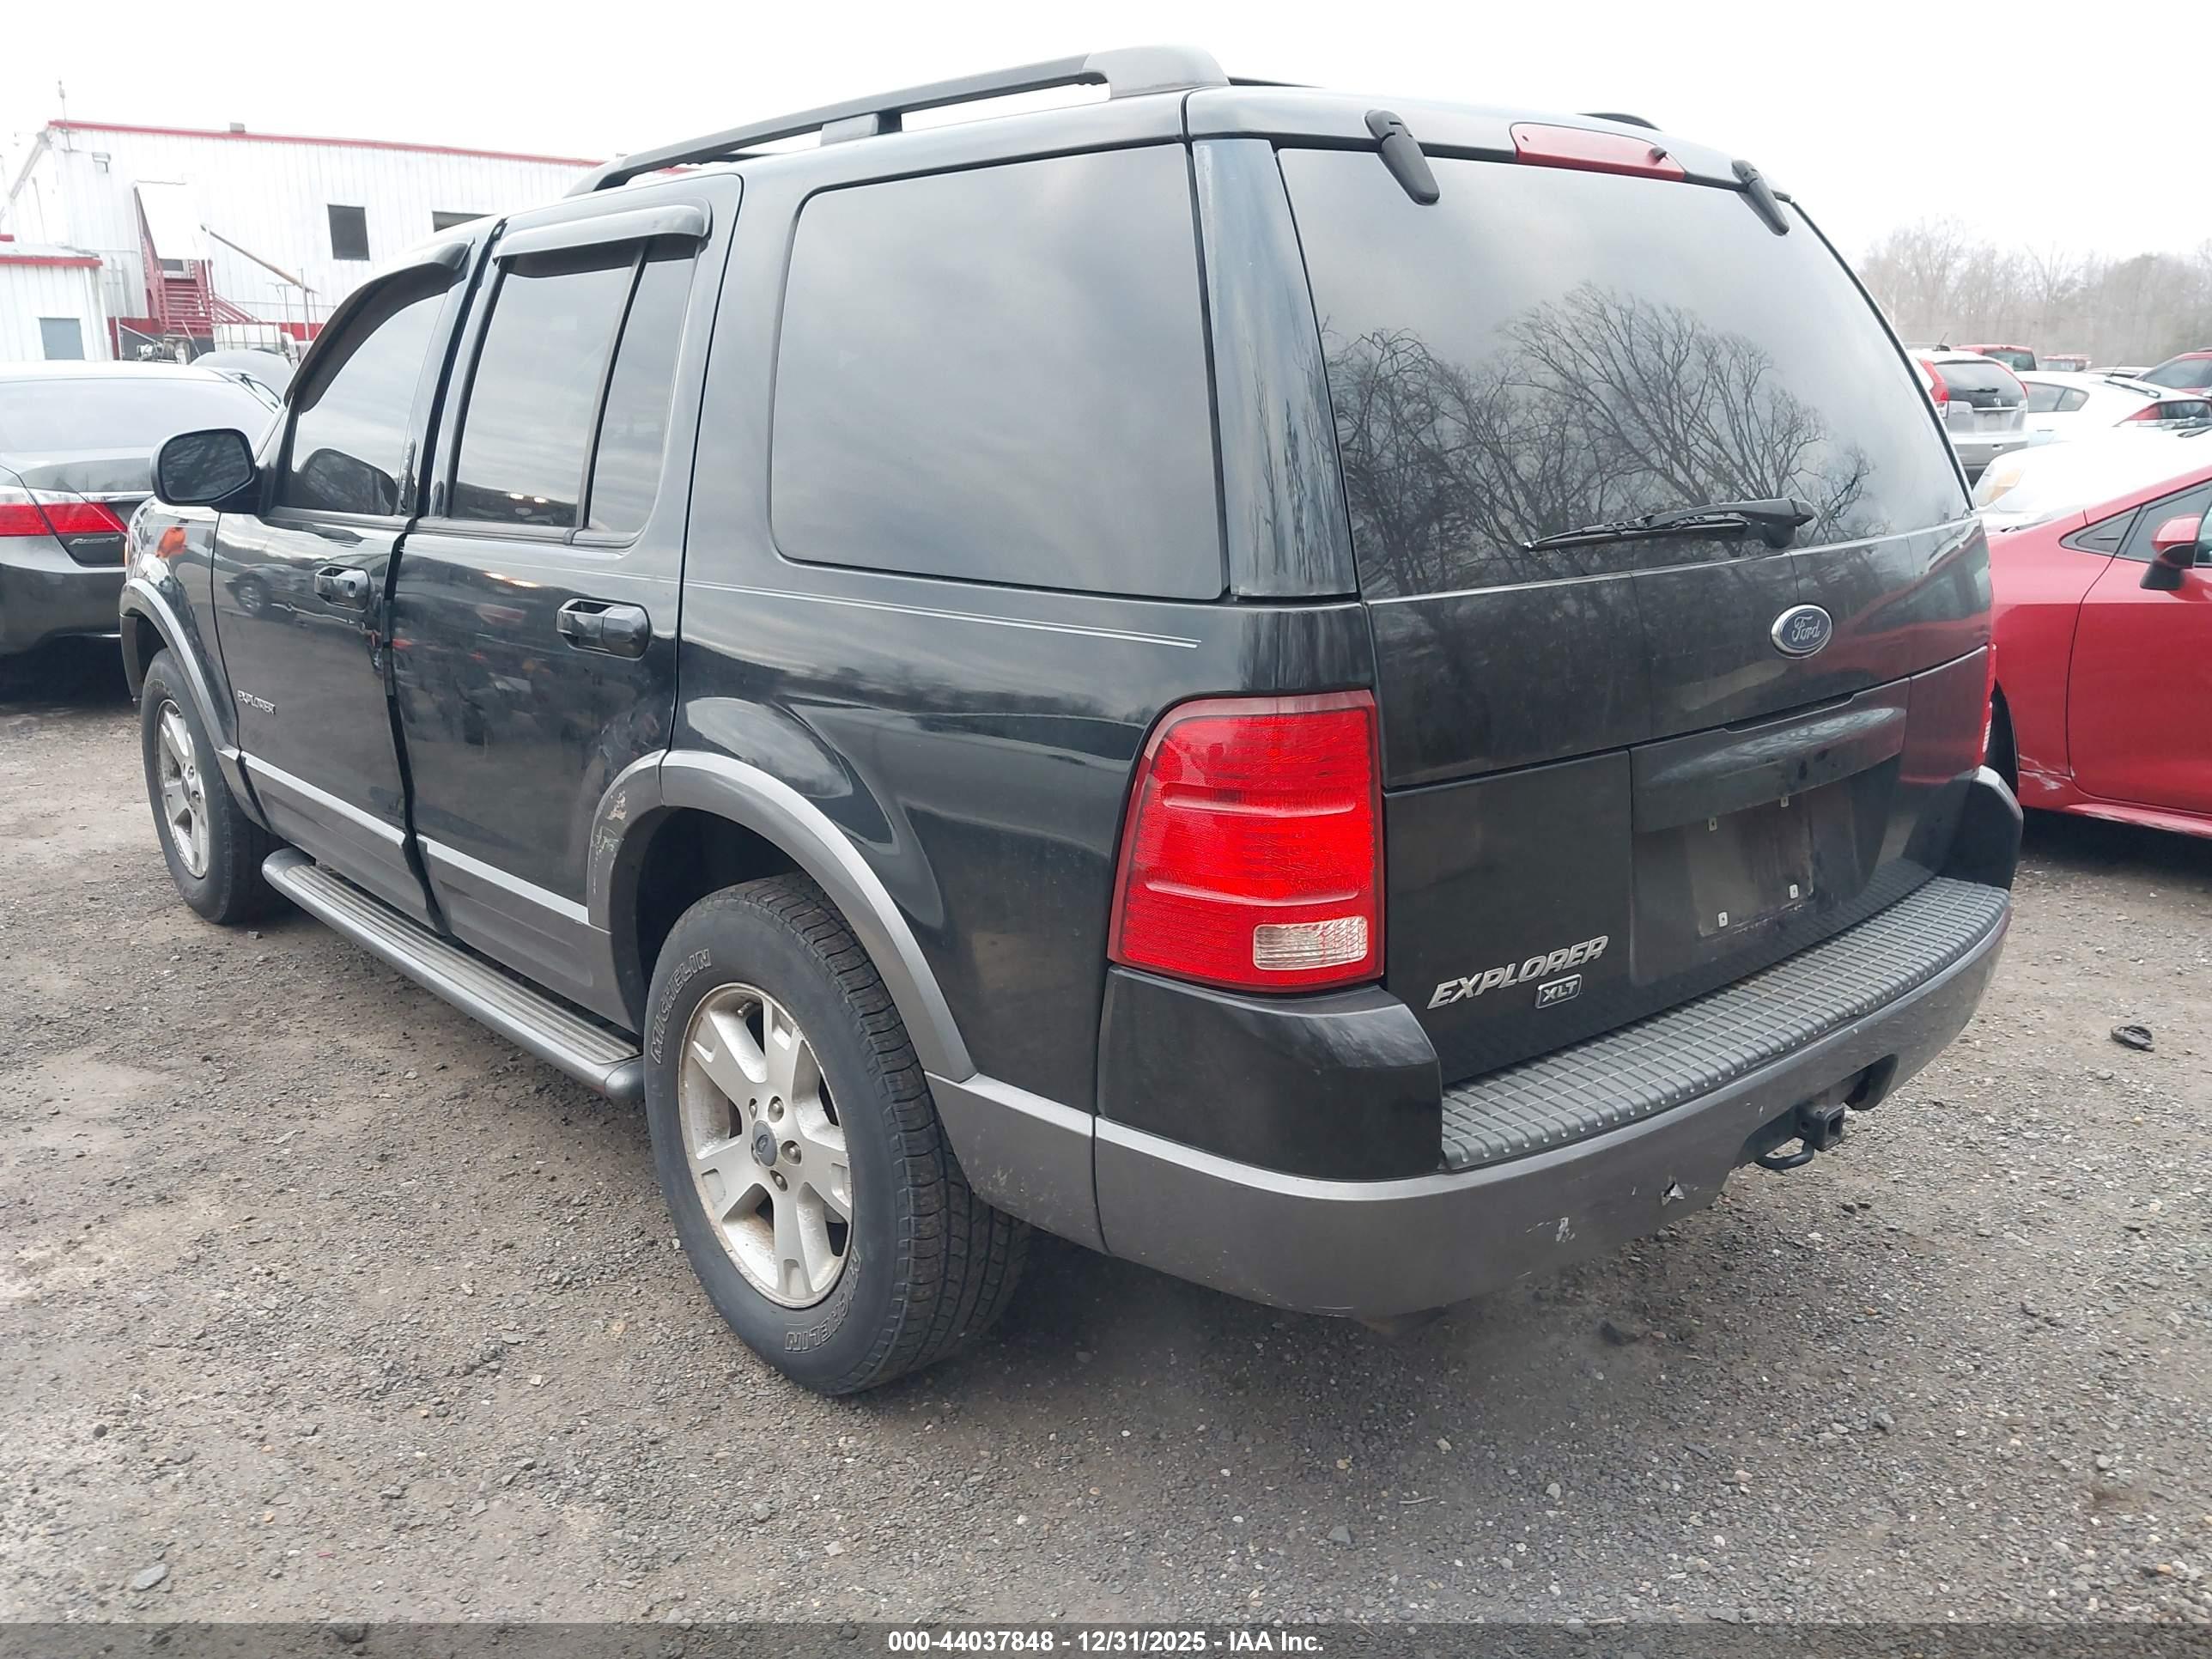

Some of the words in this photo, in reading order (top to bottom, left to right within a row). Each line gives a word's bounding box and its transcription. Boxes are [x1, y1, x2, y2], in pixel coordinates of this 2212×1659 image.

[1791, 616, 1821, 642] Ford
[236, 690, 276, 714] EXPLORER
[1426, 935, 1609, 1010] EXPLORER
[1542, 980, 1578, 1003] XLT
[651, 948, 713, 1065] MICHELIN
[785, 1245, 862, 1352] MICHELIN
